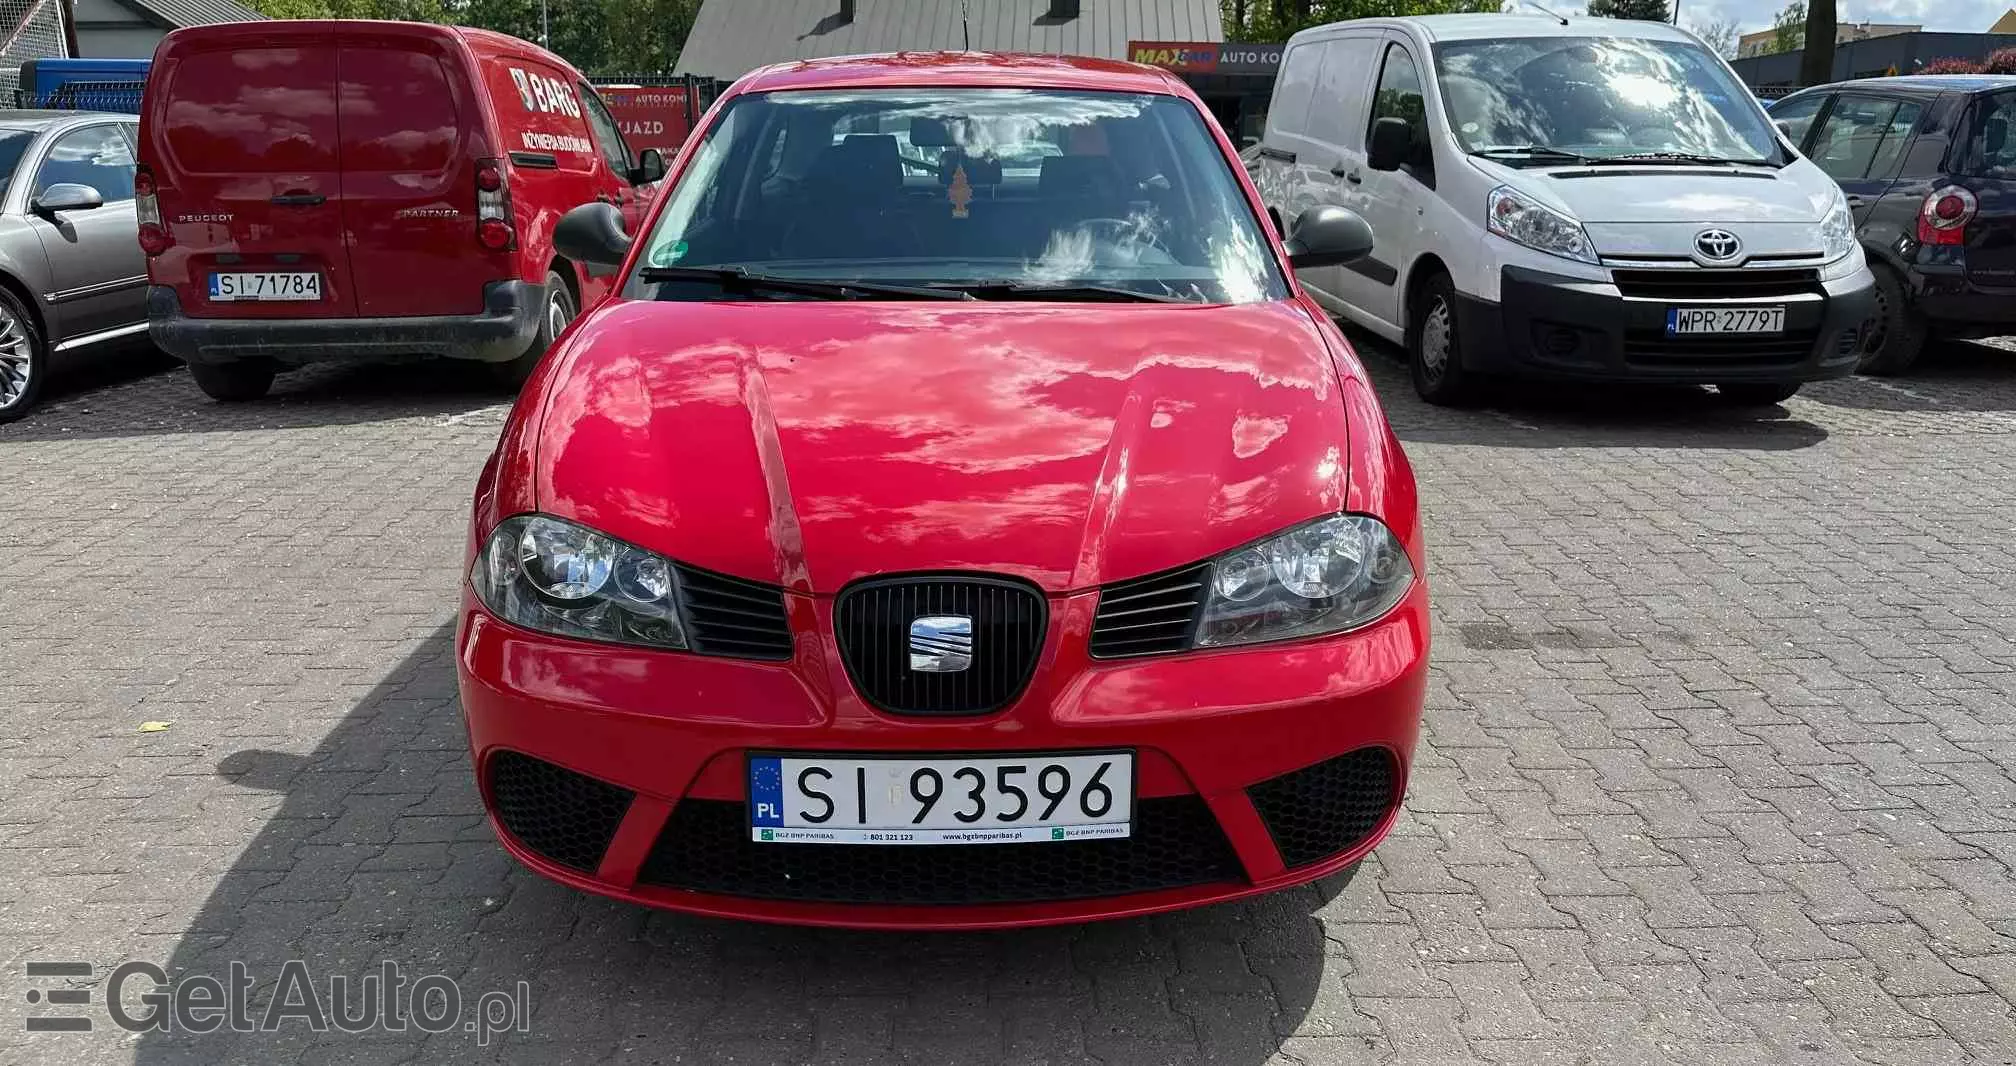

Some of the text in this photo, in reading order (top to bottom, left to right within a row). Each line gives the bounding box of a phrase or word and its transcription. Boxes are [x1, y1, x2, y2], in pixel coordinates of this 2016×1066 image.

[1220, 51, 1256, 64] AUTO
[1261, 52, 1280, 64] KO
[528, 72, 581, 119] BARG
[635, 94, 660, 104] AUTO
[662, 94, 688, 104] KOMI
[178, 213, 234, 222] PEUGEOT
[403, 208, 459, 217] PARTNER
[221, 275, 244, 294] SI
[255, 275, 317, 294] 71784
[1679, 310, 1716, 331] WPR
[1723, 310, 1783, 331] 2779T
[757, 761, 1113, 824] PL SI 93596
[942, 831, 1022, 841] www.bgzbnpparibas.pl
